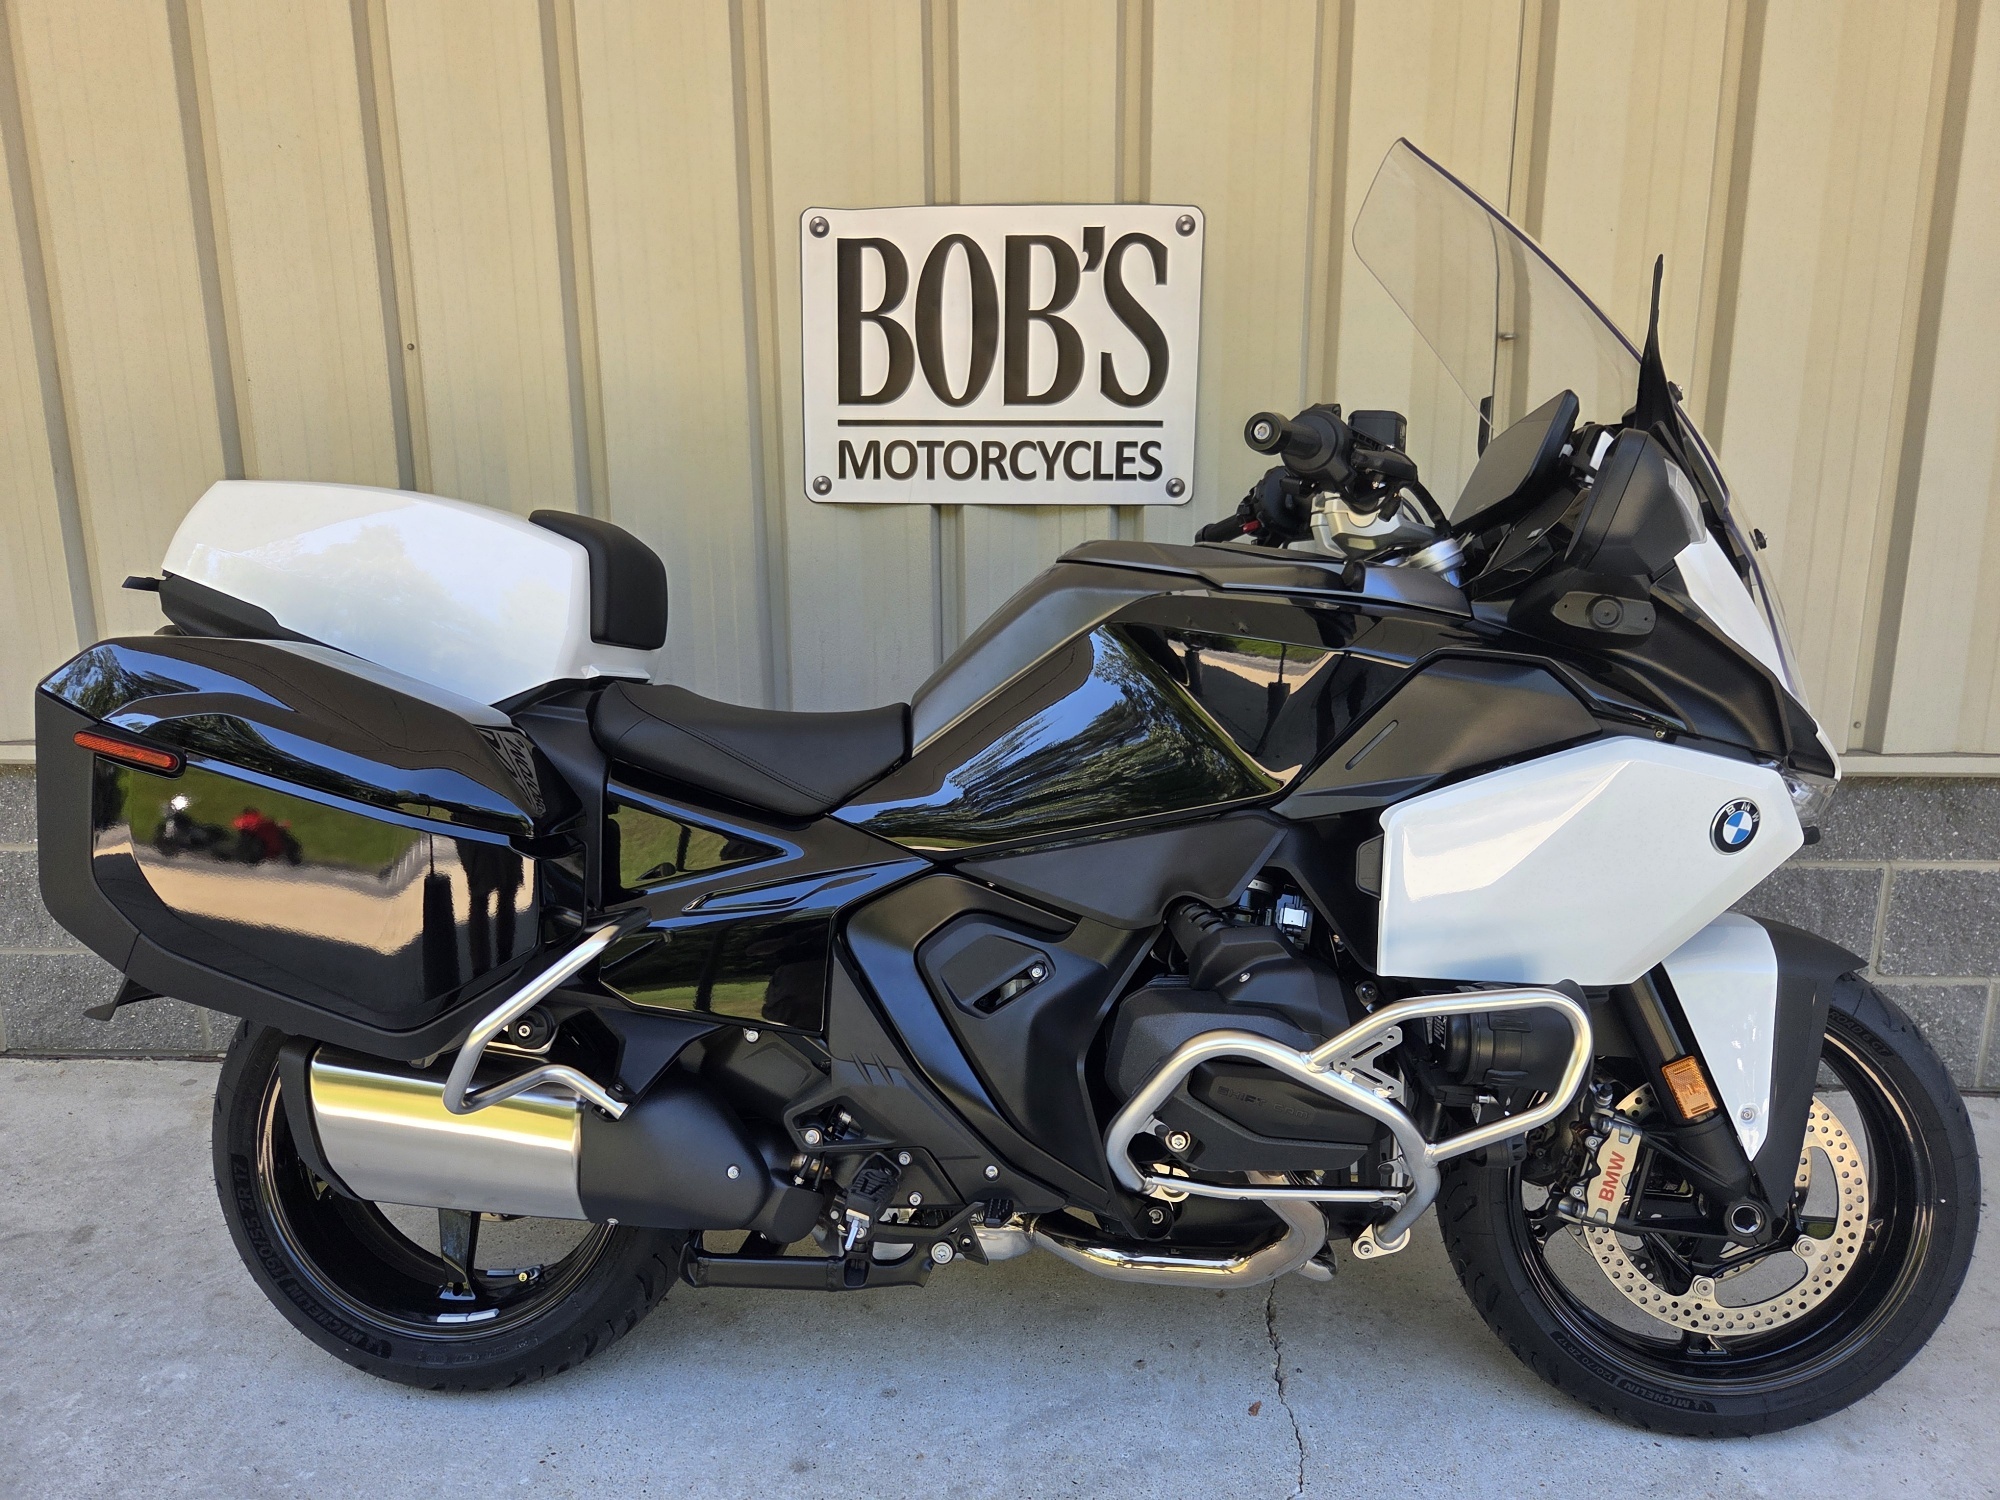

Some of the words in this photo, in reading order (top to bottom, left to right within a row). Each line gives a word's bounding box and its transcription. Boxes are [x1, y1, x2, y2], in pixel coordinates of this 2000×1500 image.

[837, 225, 1170, 408] BOB'S
[838, 440, 1163, 481] MOTORCYCLES
[1725, 801, 1760, 823] BMW
[1217, 1086, 1267, 1107] SHIFT
[1598, 1150, 1626, 1203] BMW
[285, 1282, 365, 1344] MICHELIN
[1581, 1355, 1613, 1380] 120/70
[1623, 1382, 1691, 1409] MICHELIN
